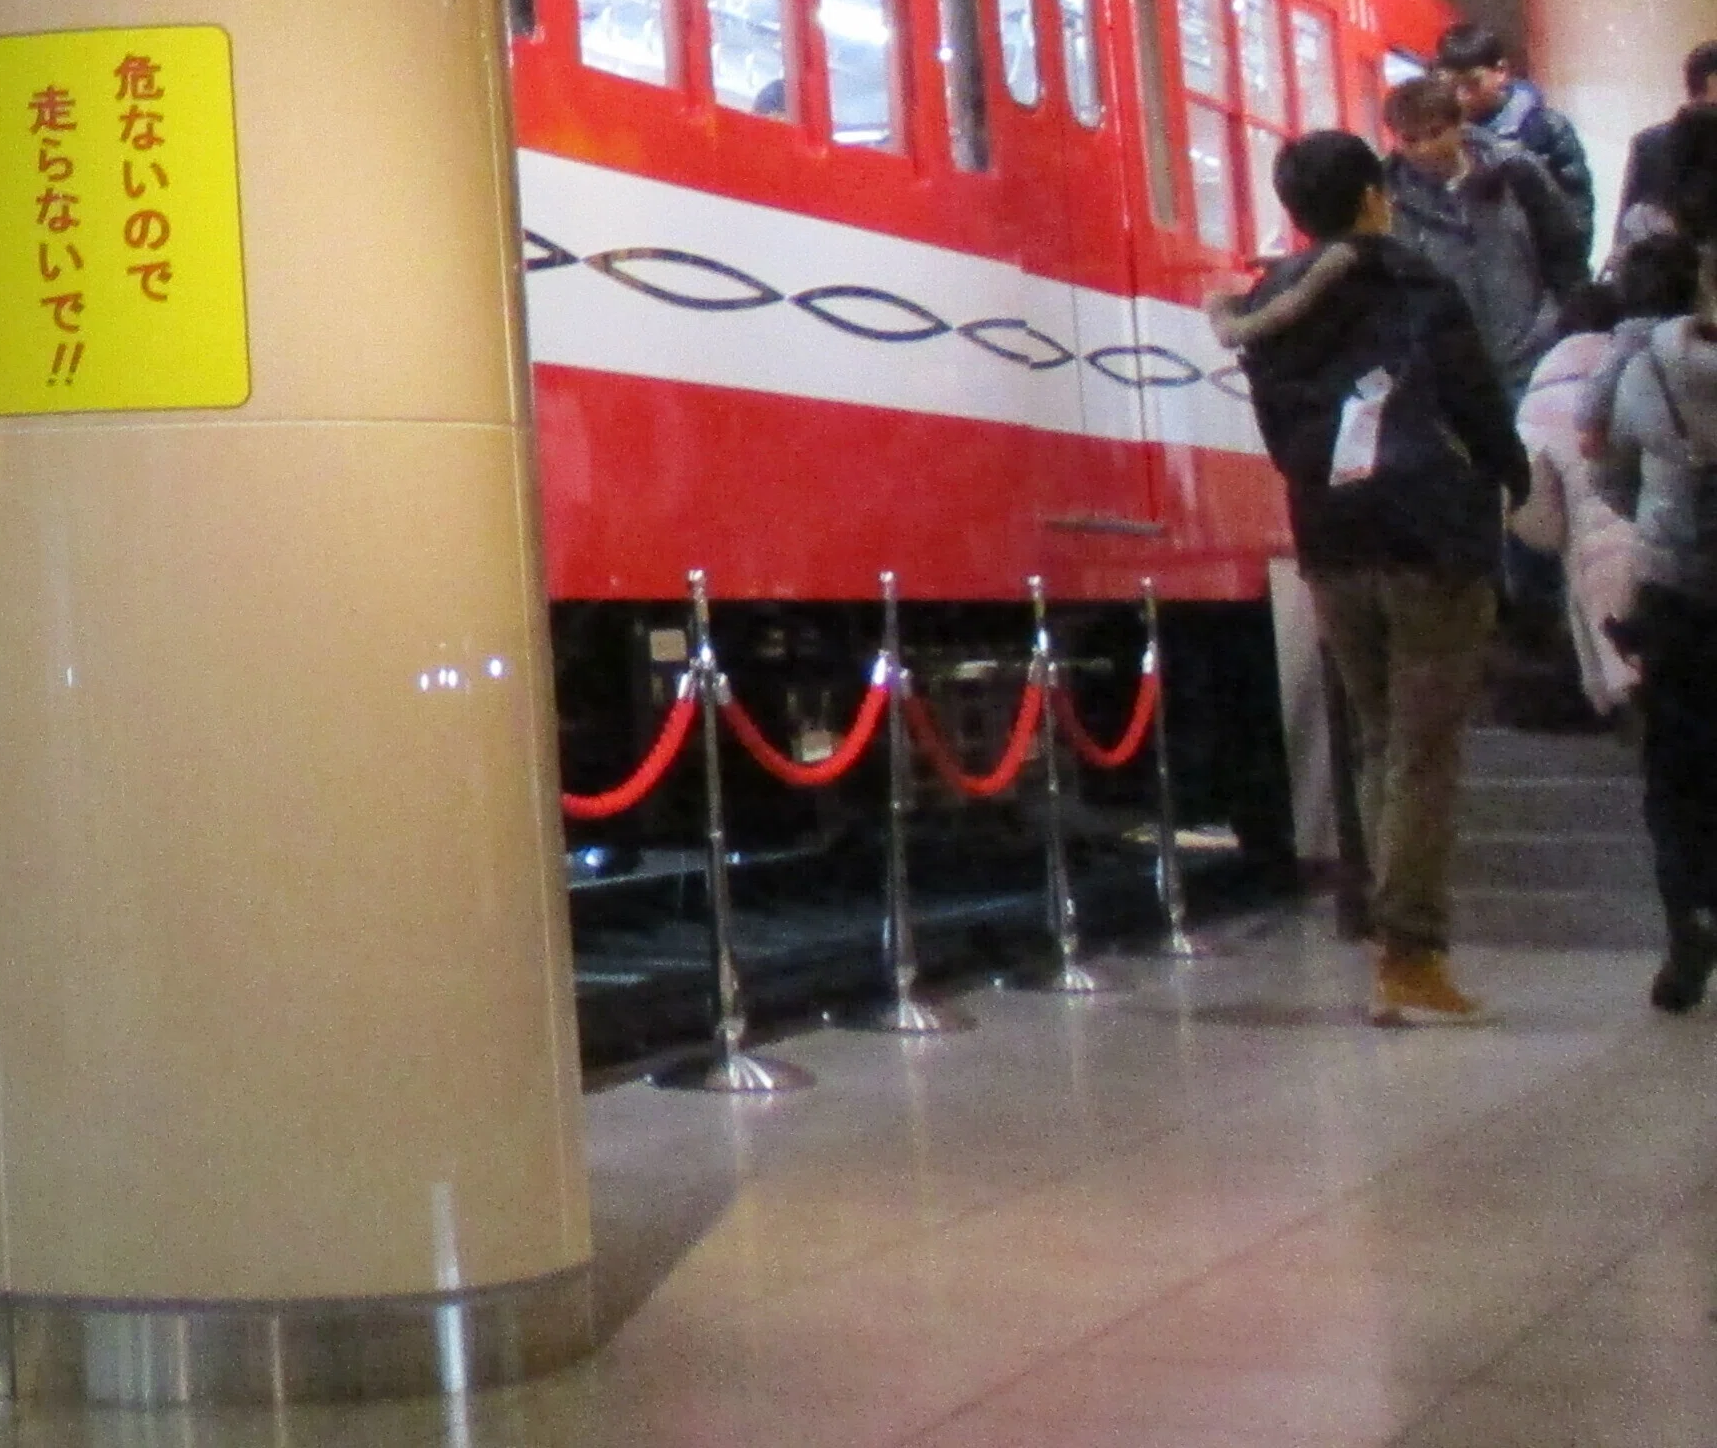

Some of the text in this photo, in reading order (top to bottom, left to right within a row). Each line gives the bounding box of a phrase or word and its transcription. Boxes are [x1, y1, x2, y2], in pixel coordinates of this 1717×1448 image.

[113, 53, 173, 303] 危ないので
